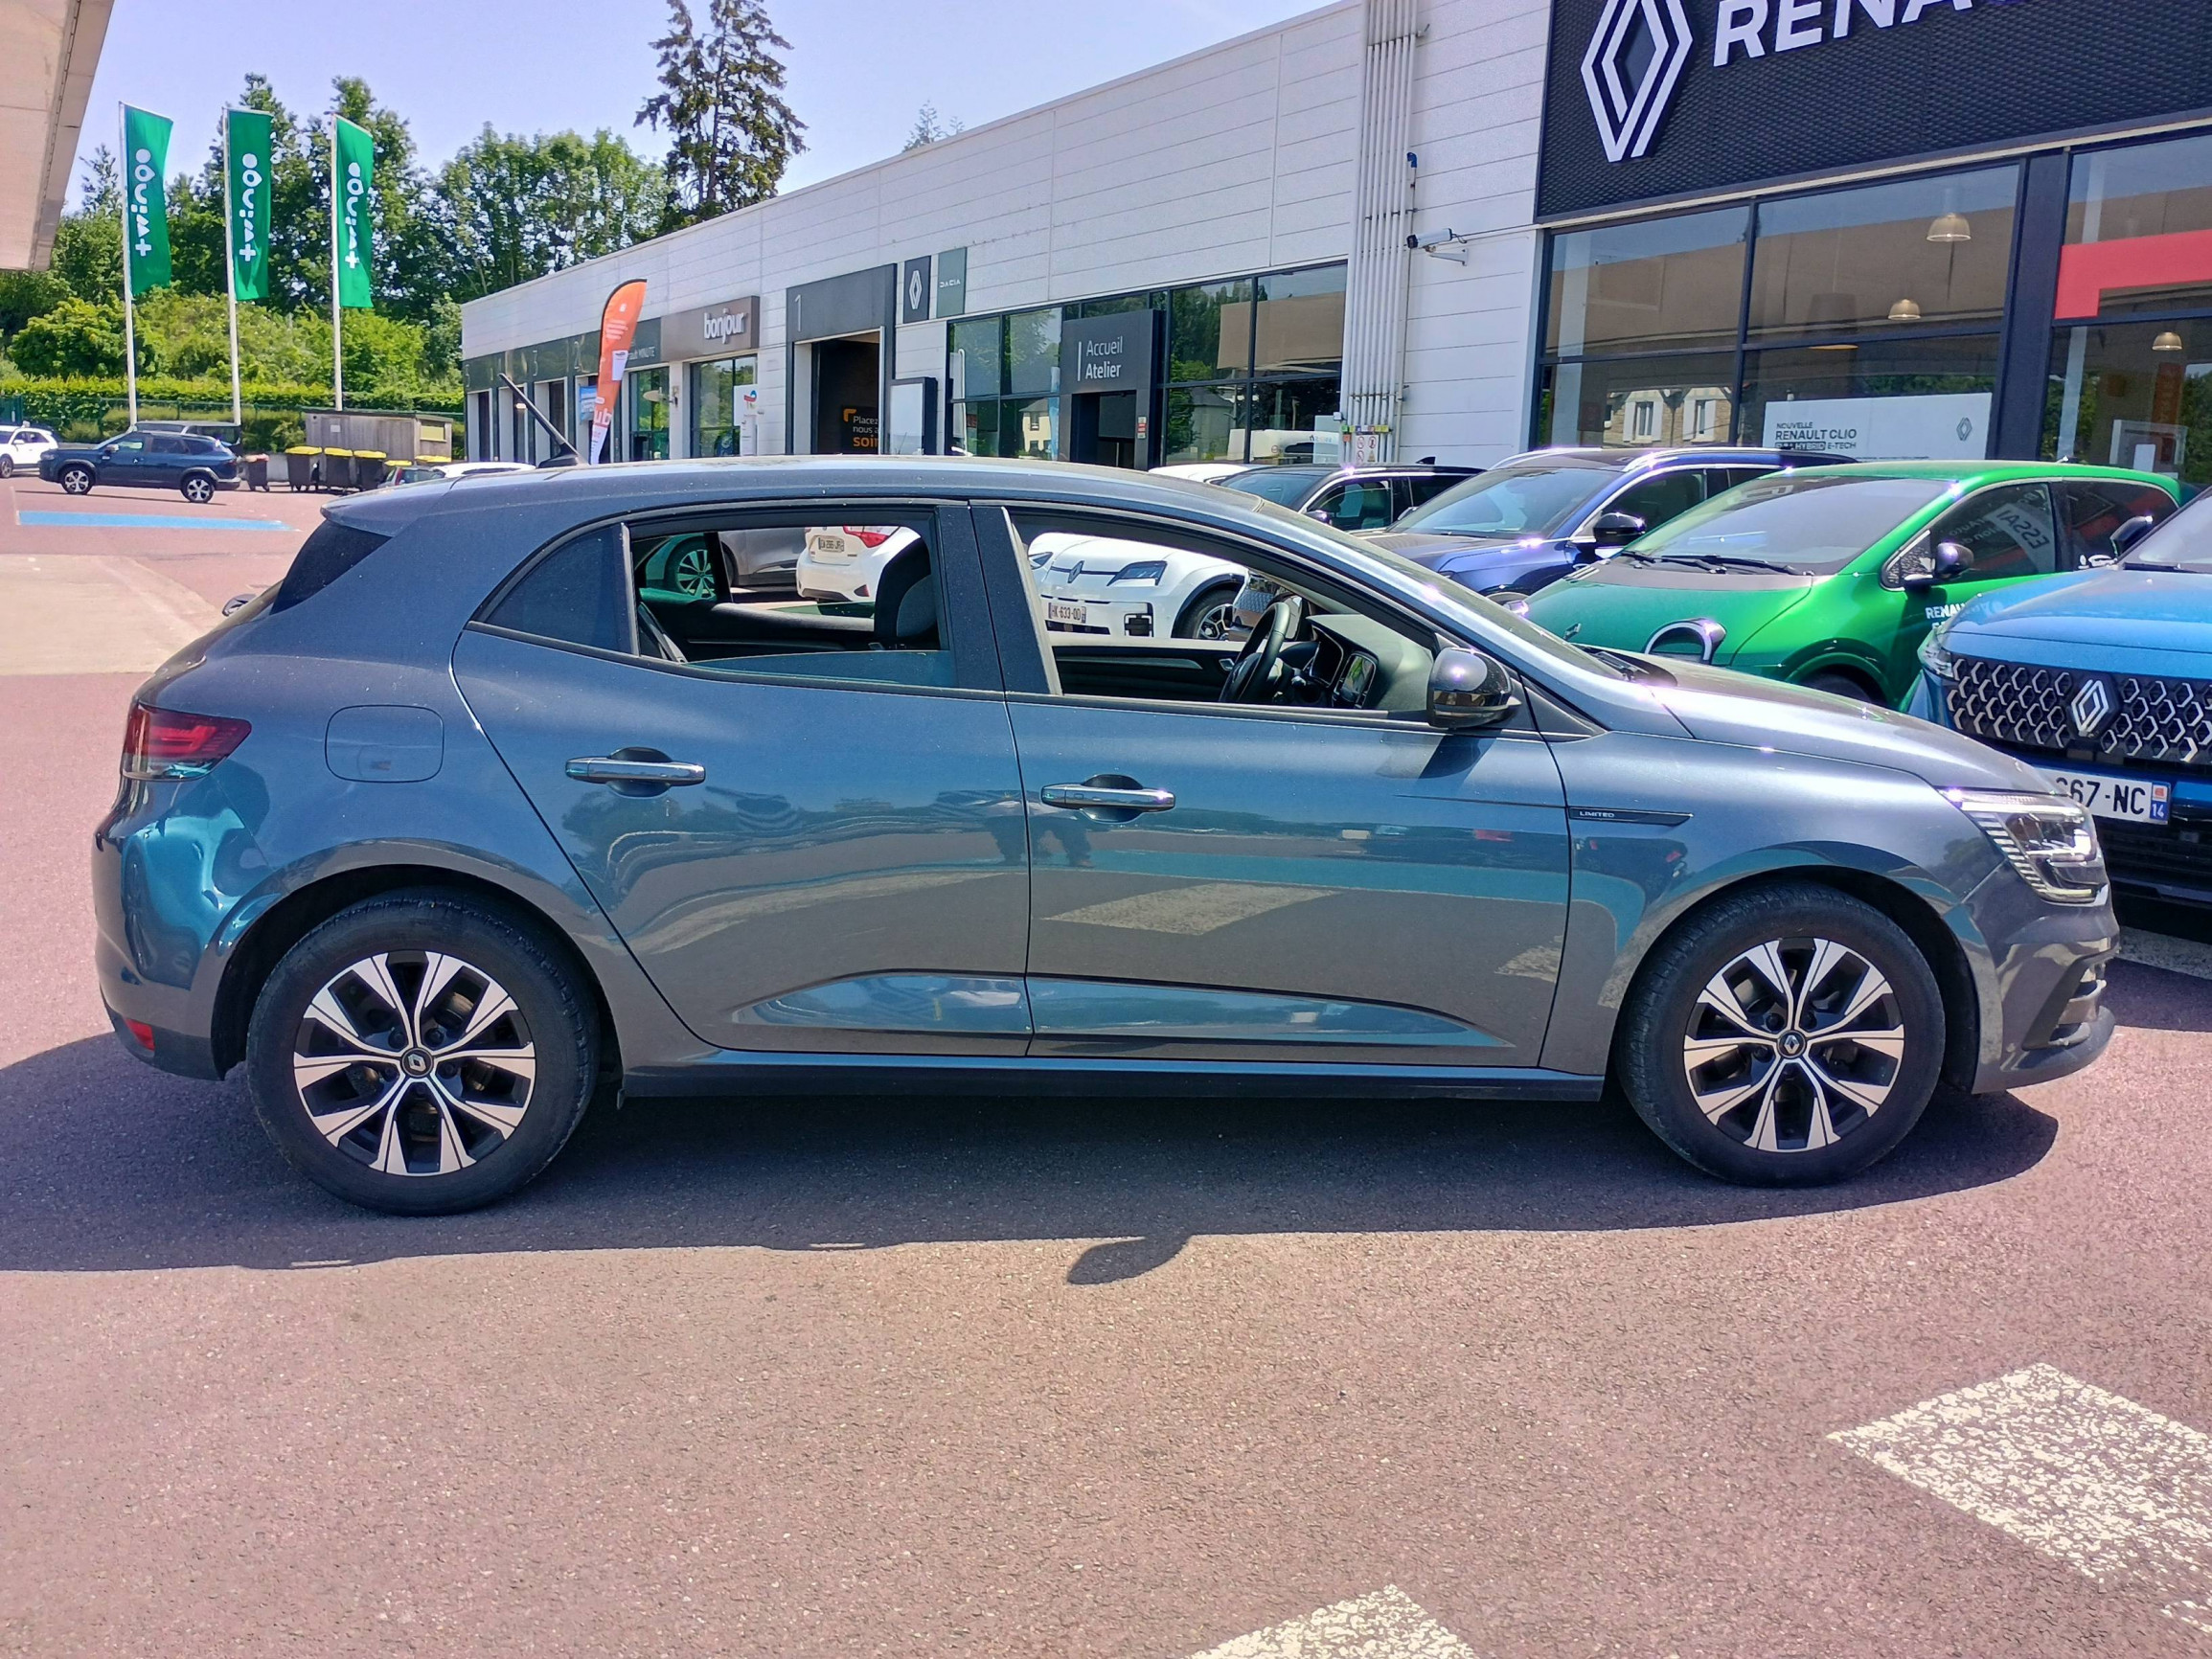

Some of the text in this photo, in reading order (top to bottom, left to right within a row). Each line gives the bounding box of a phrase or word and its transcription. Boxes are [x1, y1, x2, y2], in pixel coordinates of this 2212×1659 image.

[1713, 0, 1973, 66] REN
[939, 279, 961, 288] DACIA
[794, 294, 802, 332] 1
[704, 307, 744, 344] bonjour
[1085, 335, 1123, 357] Accueil
[1084, 361, 1122, 379] Atelier
[1775, 428, 1857, 440] RENAULT CLIO
